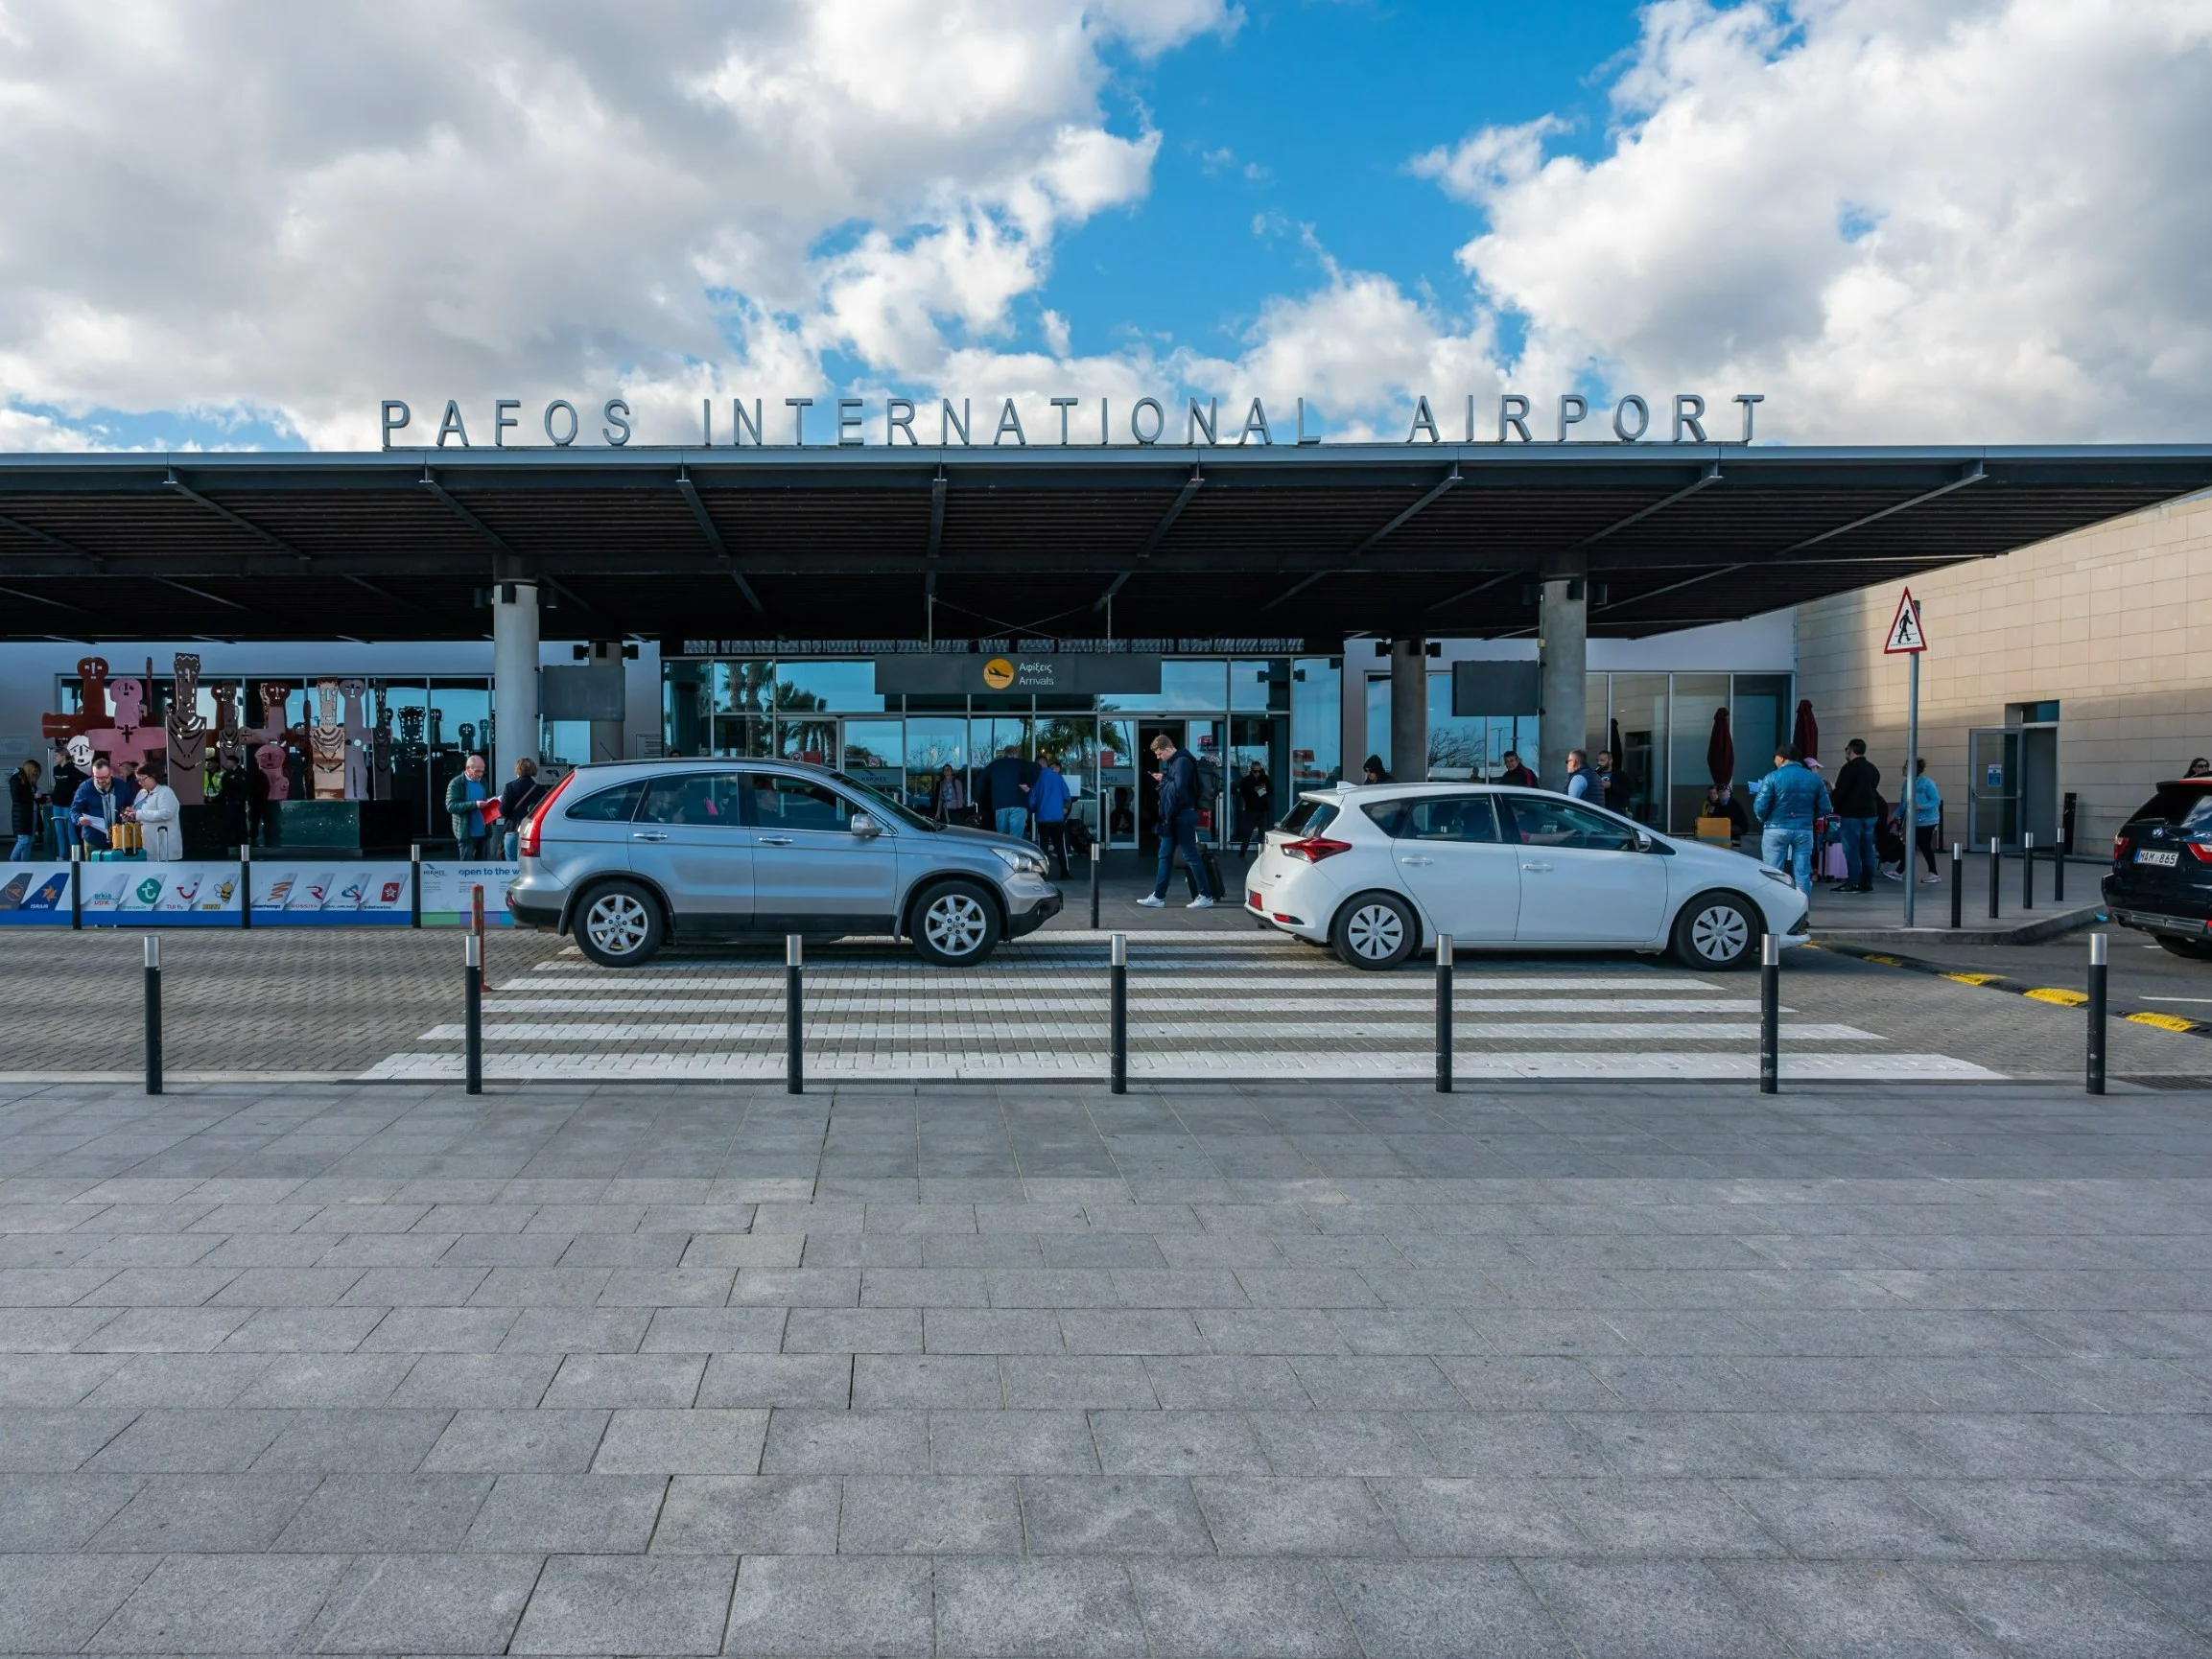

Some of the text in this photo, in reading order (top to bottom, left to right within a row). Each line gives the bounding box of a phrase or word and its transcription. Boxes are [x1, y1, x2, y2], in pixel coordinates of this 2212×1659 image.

[381, 394, 1765, 447] PAFOS INTERNATIONAL AIRPORT
[1019, 662, 1052, 673] Αφίξεις
[1019, 676, 1054, 686] Arrivals
[2140, 851, 2176, 865] MAM 865
[459, 868, 482, 876] open
[483, 867, 493, 876] to
[494, 867, 510, 876] the
